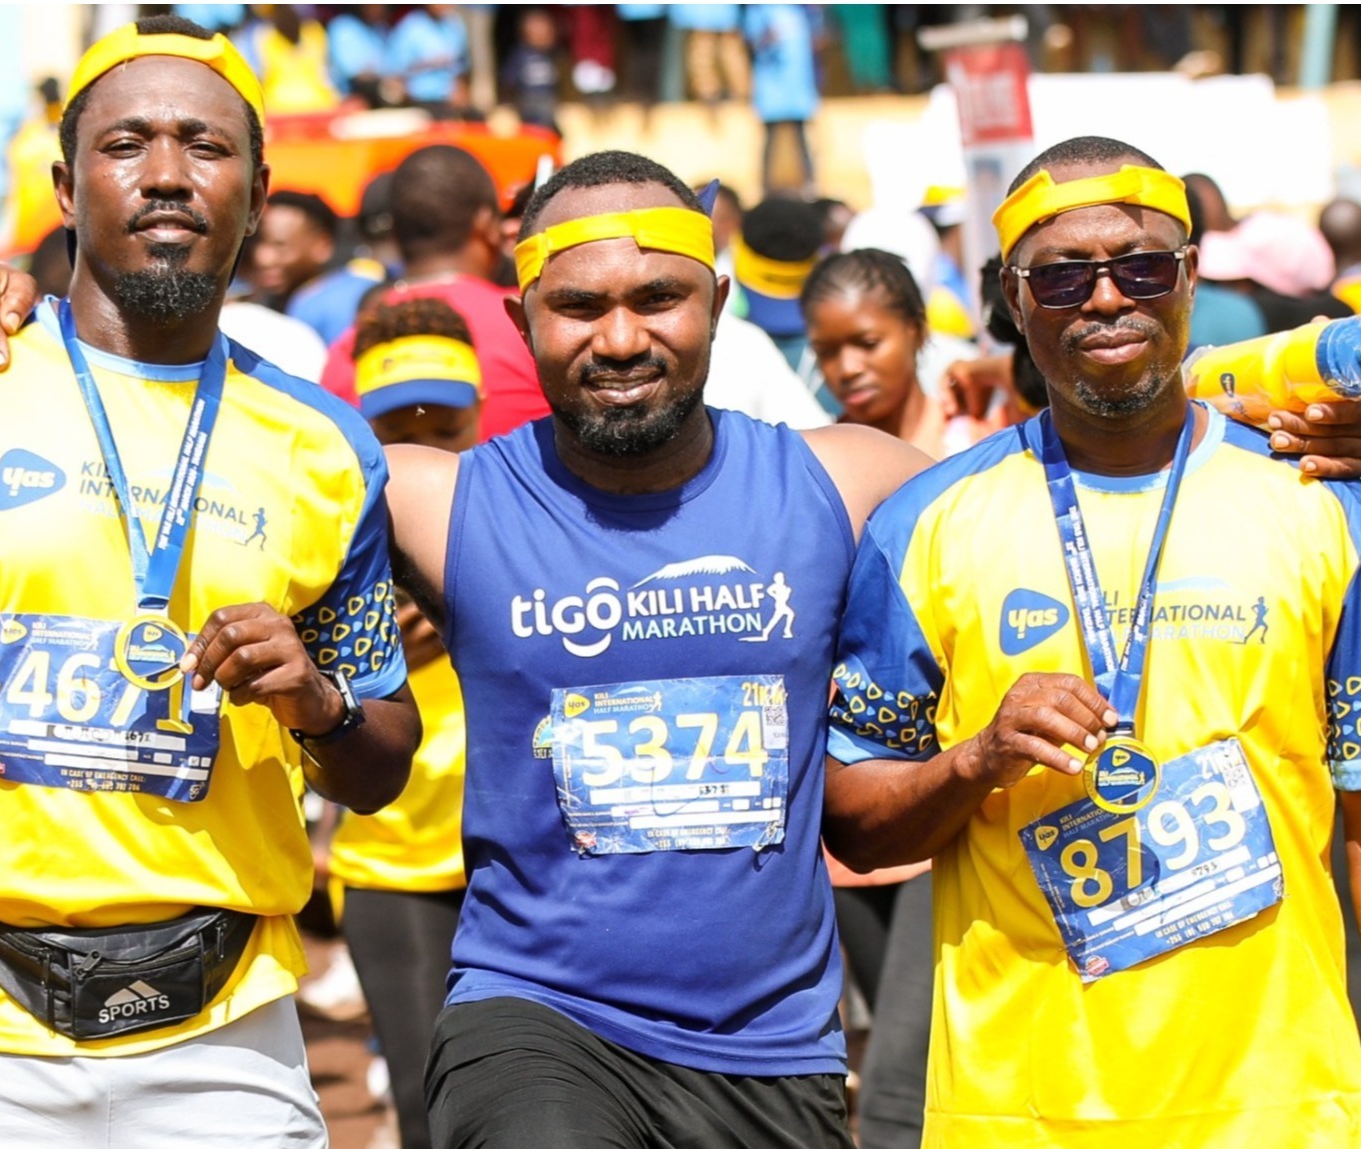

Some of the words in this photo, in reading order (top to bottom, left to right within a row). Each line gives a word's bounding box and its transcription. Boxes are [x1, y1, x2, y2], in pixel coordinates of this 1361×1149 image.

[2, 465, 56, 496] yas
[81, 461, 112, 479] KIL
[80, 479, 247, 525] INTRNAONAL
[627, 588, 684, 617] KILI
[691, 583, 765, 612] HALF
[622, 613, 763, 641] MARATHON
[1009, 606, 1058, 639] yas
[1150, 624, 1246, 640] ARATHON
[582, 711, 769, 786] 5374
[1060, 781, 1246, 907] 8793
[98, 994, 171, 1023] SPORTS
